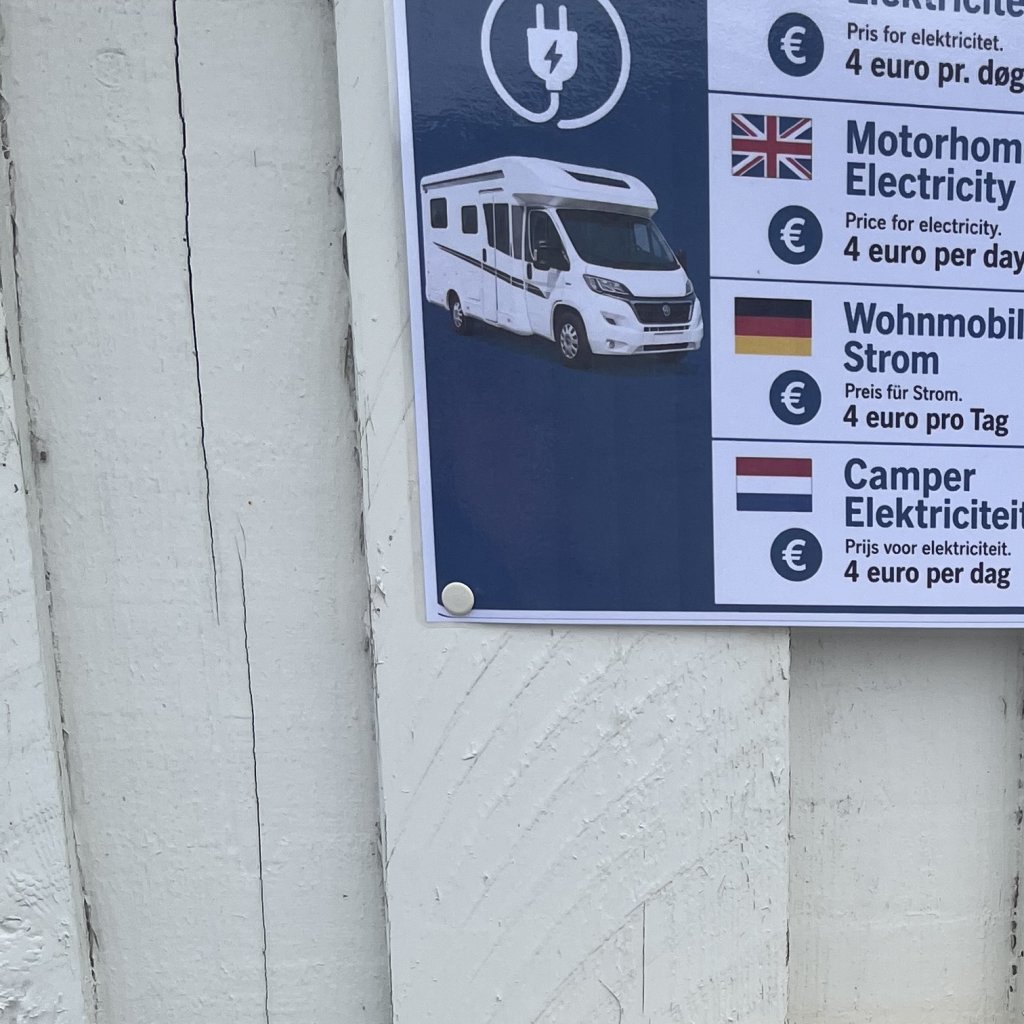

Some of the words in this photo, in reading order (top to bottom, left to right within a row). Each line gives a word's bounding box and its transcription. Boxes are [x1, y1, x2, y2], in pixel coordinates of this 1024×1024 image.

[848, 23, 878, 41] Pris
[883, 26, 906, 43] for
[912, 29, 1003, 51] elektricitet.
[846, 49, 862, 75] 4
[871, 57, 929, 80] euro
[939, 63, 969, 87] pr.
[847, 162, 1016, 211] Electricity
[846, 212, 886, 229] Price
[892, 215, 914, 231] for
[920, 217, 1001, 239] electricity.
[844, 236, 860, 261] 4
[869, 244, 926, 264] euro
[935, 247, 976, 271] per
[844, 302, 1024, 339] Wohnmobil
[844, 341, 938, 374] Strom
[846, 383, 882, 399] Preis
[887, 384, 908, 399] für
[914, 385, 962, 401] Strom.
[843, 405, 858, 427] 4
[867, 411, 918, 428] euro
[927, 413, 963, 434] pro
[970, 408, 1008, 436] Tag
[845, 458, 976, 498] Camper
[846, 539, 879, 557] Prijs
[884, 544, 917, 554] voor
[922, 541, 1011, 556] elektriciteit.
[844, 560, 859, 582] 4
[868, 567, 919, 583] euro
[927, 567, 964, 588] per
[971, 562, 1011, 589] dag
